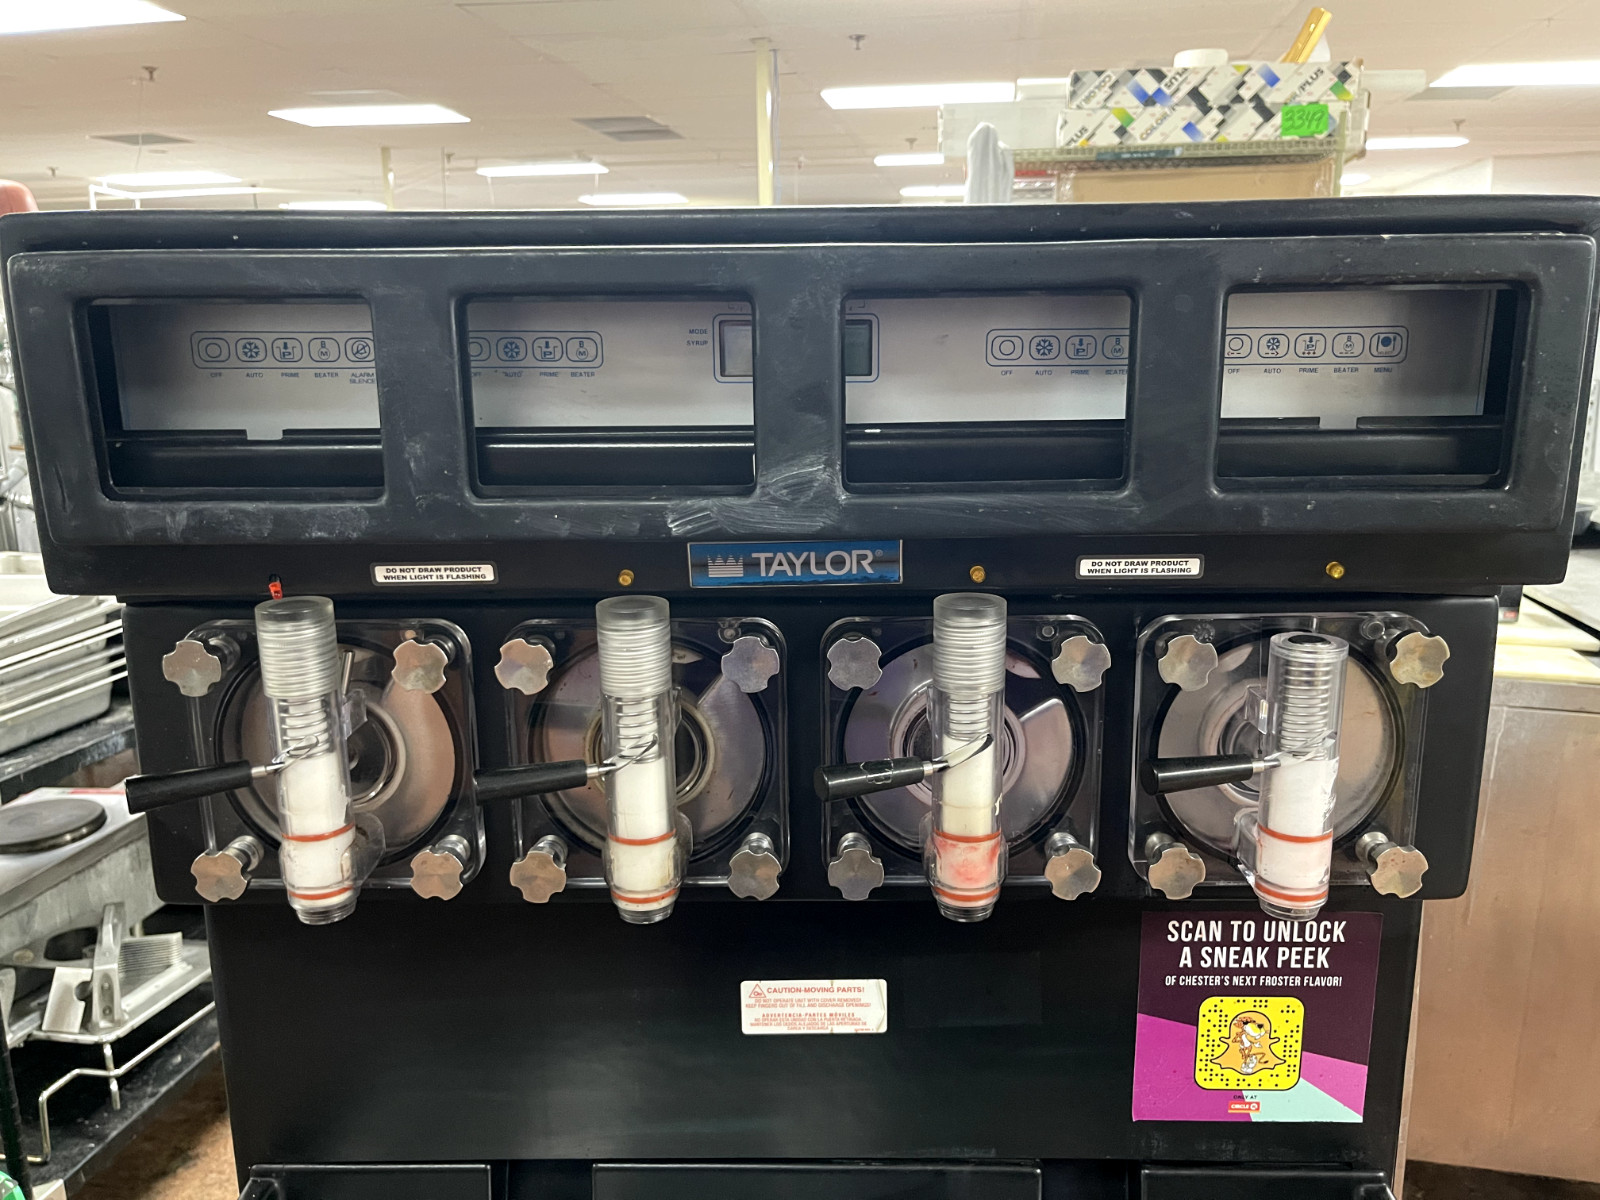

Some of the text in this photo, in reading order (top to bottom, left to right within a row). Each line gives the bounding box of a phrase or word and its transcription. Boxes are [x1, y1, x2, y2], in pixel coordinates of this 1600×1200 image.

[1167, 920, 1347, 943] SCAN TO UNLOCK
[1179, 946, 1331, 969] A SNEAK PEEK
[1165, 975, 1343, 987] OF CHESTER'S NEXT FROSTER FLAVOR!
